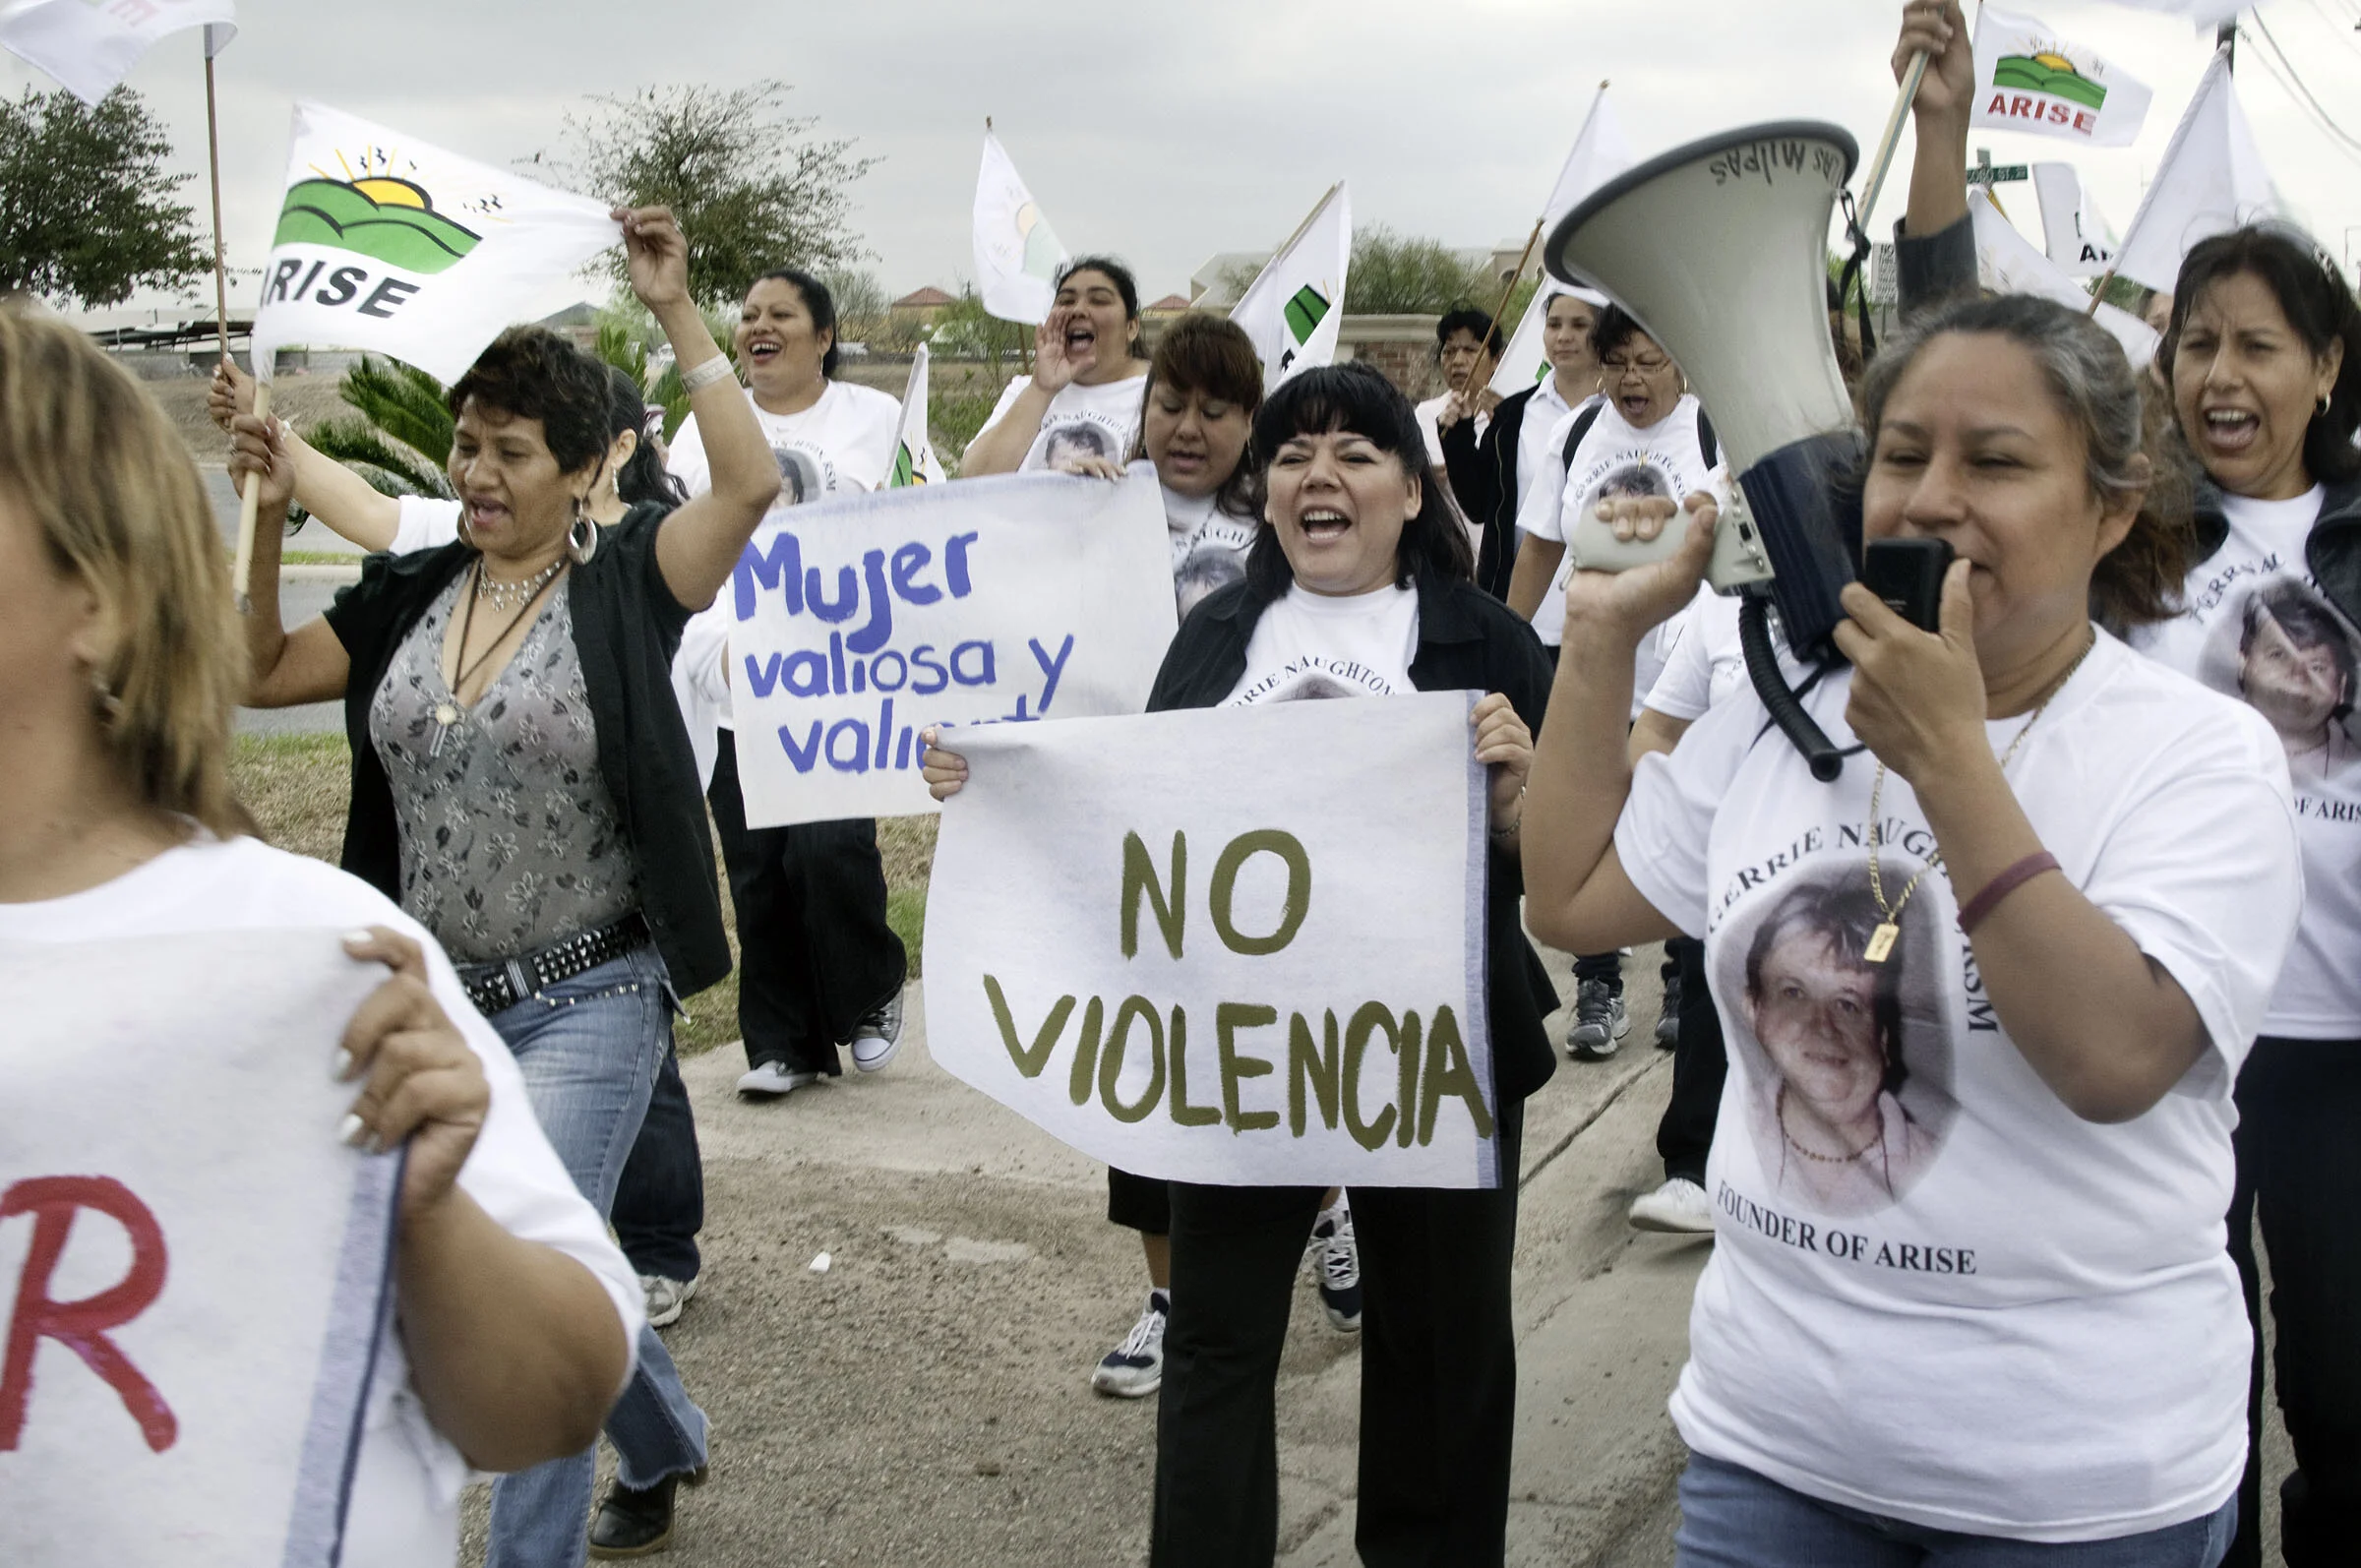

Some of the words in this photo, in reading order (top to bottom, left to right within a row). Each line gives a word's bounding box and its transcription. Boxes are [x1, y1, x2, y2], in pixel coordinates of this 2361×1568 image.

[1987, 92, 2096, 136] ARISE
[260, 259, 421, 319] RISE
[733, 531, 978, 654] Mujer
[745, 631, 997, 698] valiosa
[1028, 633, 1074, 713] y
[1231, 673, 1281, 707] RIE
[1121, 828, 1311, 960] NO
[984, 973, 1494, 1152] VIOLENCIA
[1717, 1178, 1818, 1252] FOUNDER
[1826, 1230, 1869, 1262] OF
[1874, 1240, 1978, 1276] ARISE
